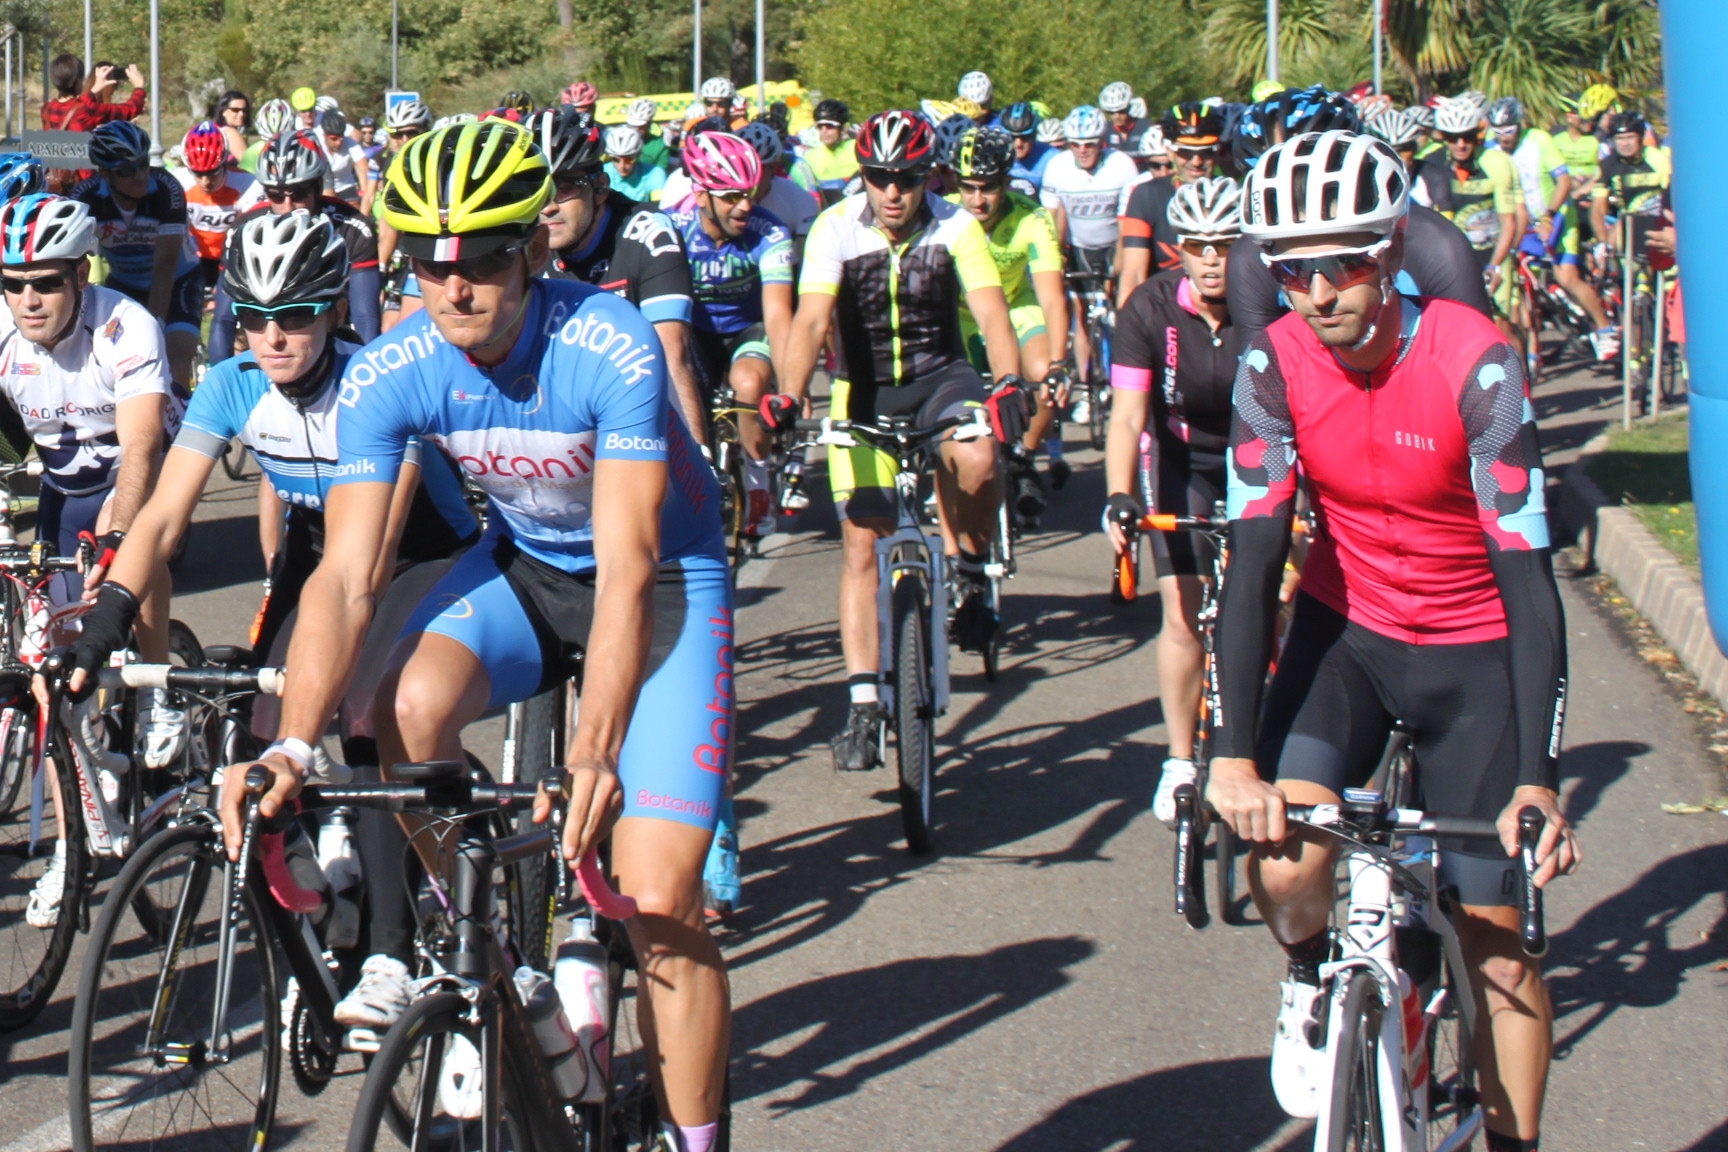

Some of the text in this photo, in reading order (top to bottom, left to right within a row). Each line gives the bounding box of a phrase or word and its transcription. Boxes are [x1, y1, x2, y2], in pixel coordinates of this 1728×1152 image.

[28, 141, 89, 160] APARCAM
[1395, 430, 1436, 452] GOBIK
[635, 789, 712, 818] Botanik
